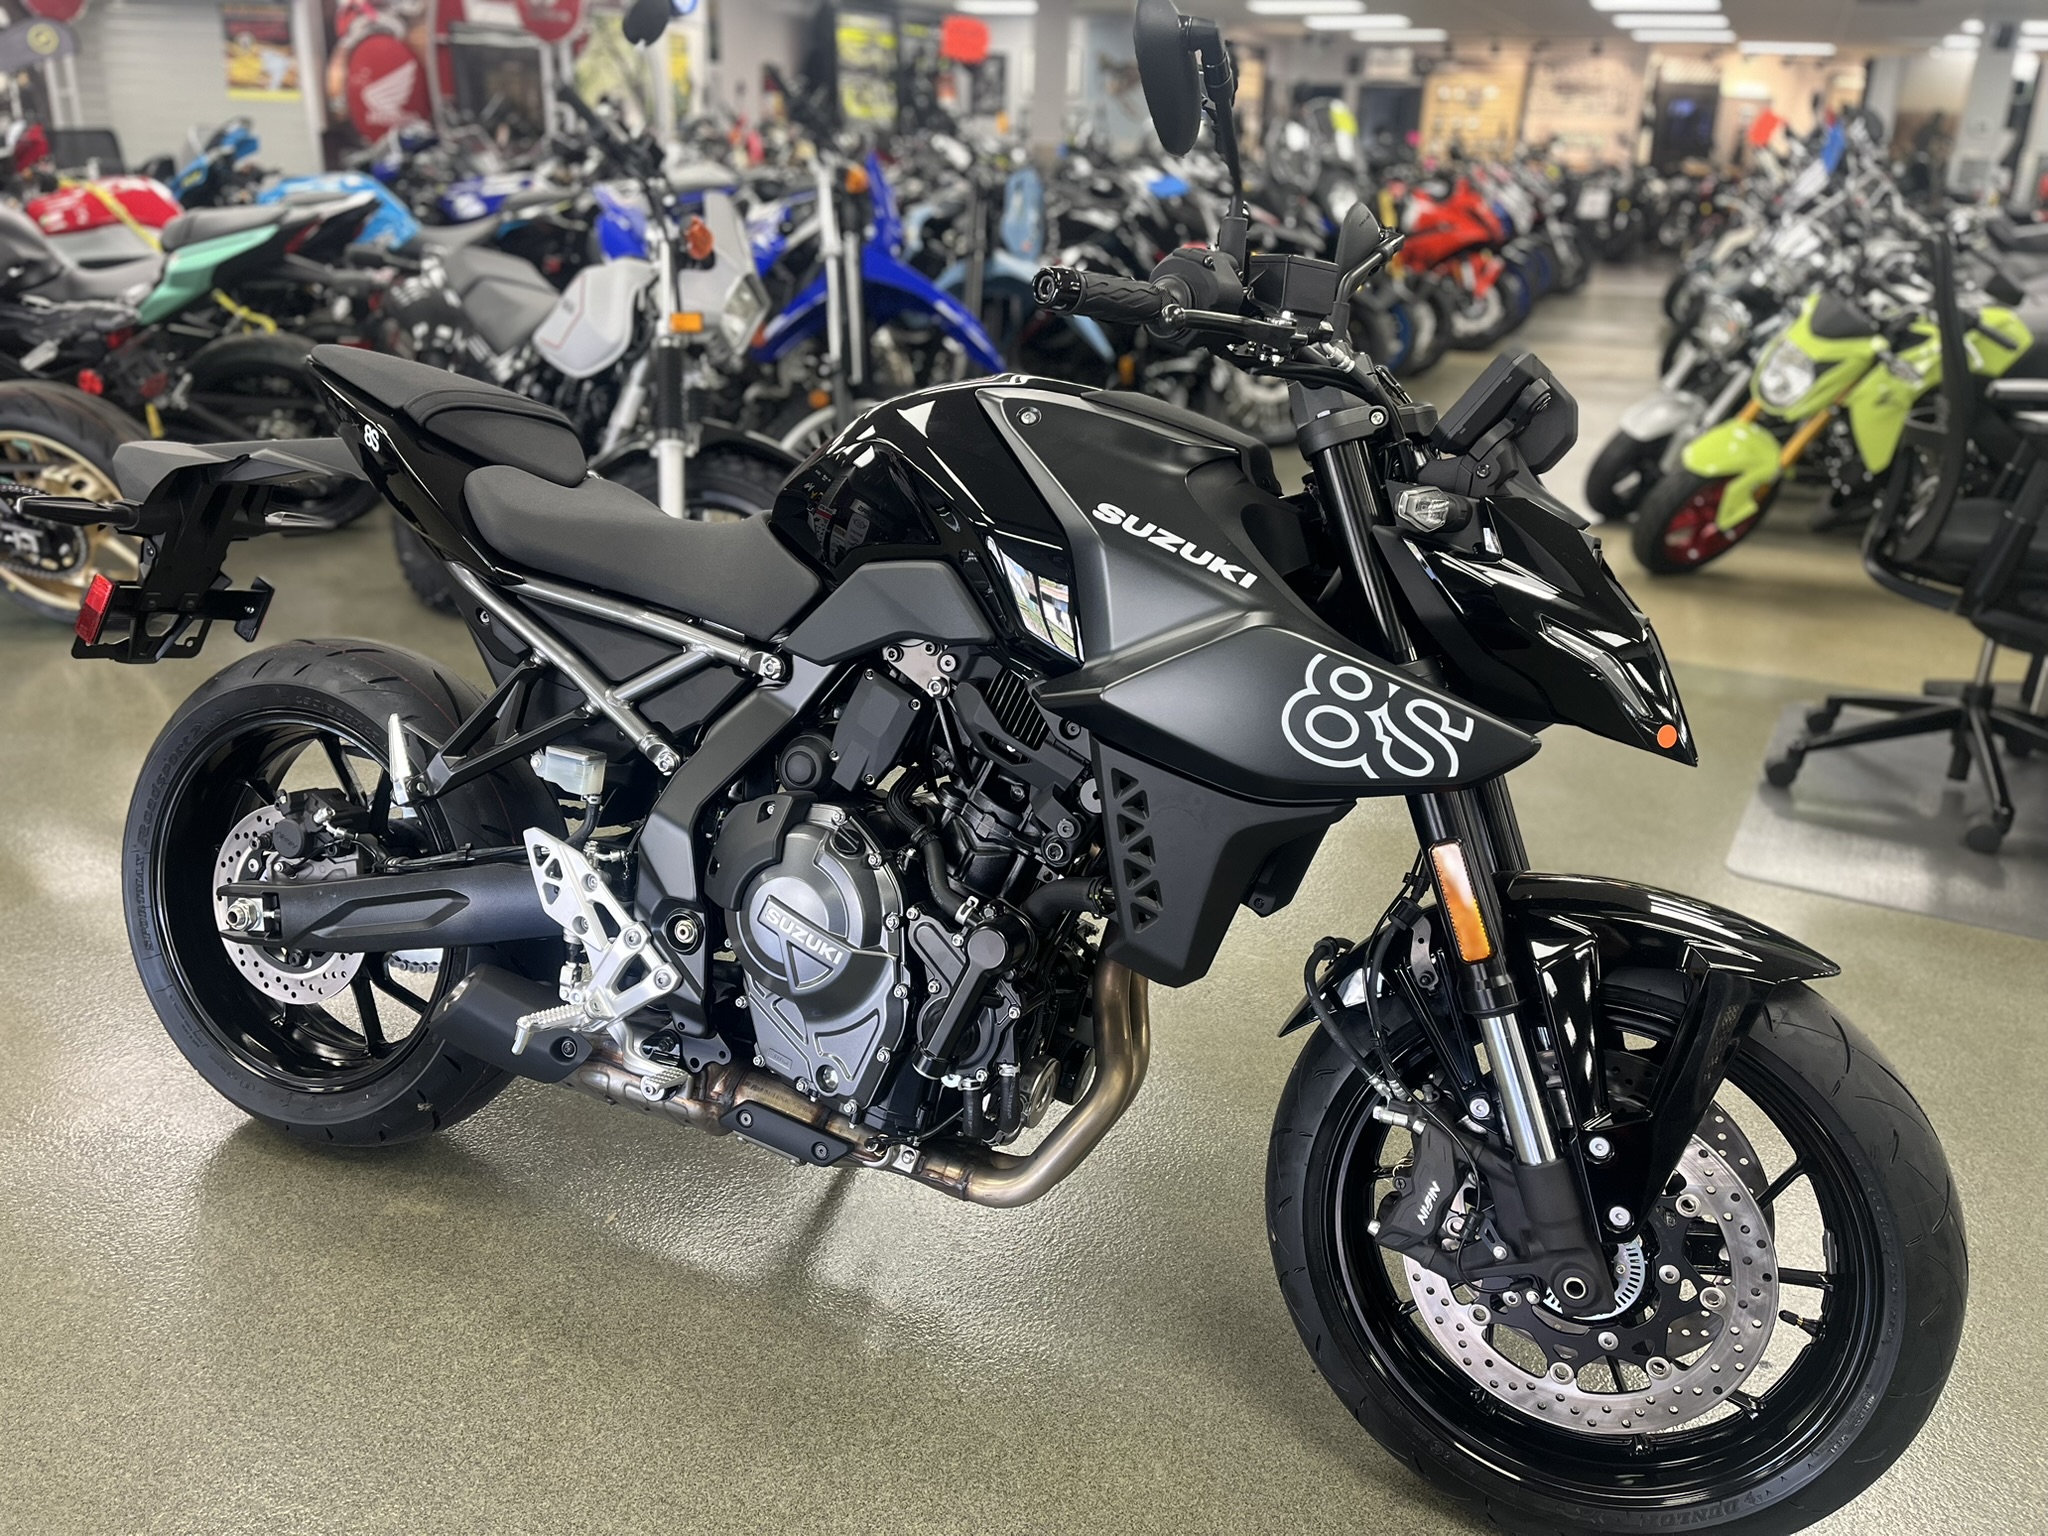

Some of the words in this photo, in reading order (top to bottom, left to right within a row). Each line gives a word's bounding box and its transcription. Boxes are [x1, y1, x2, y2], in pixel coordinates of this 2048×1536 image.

[364, 424, 379, 452] 8S
[1091, 502, 1260, 590] SUZUKI
[1281, 653, 1474, 779] 8S
[764, 907, 844, 965] SUZUKI
[1417, 1180, 1441, 1226] NISSIN
